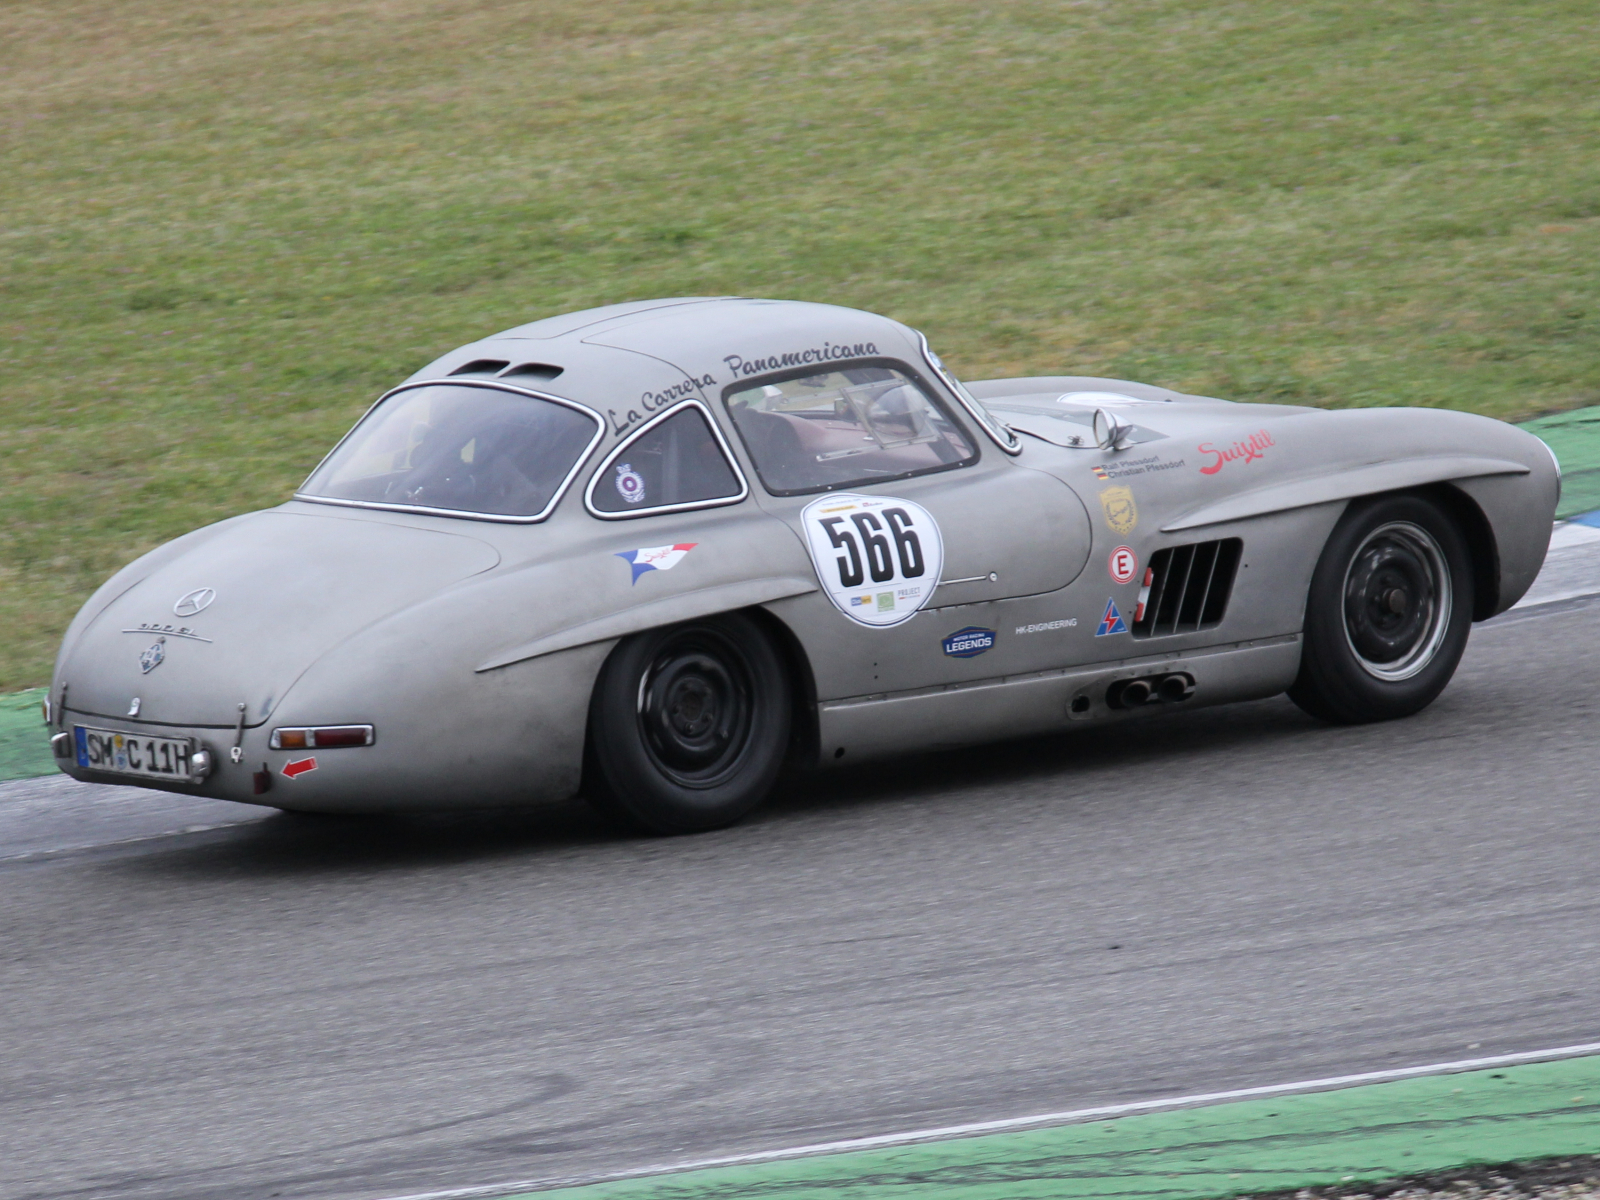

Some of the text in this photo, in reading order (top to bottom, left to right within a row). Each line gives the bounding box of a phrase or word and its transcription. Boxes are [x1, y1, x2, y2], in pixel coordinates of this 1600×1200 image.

[608, 341, 880, 437] La Carrera Panamericana
[1108, 467, 1145, 479] Christian
[817, 507, 926, 588] 566
[1117, 554, 1130, 575] E
[897, 587, 921, 596] PROJECT
[1015, 618, 1078, 634] HK-ENGINEERING
[946, 637, 992, 652] LEGENDS
[88, 733, 114, 767] SM
[127, 739, 141, 769] C
